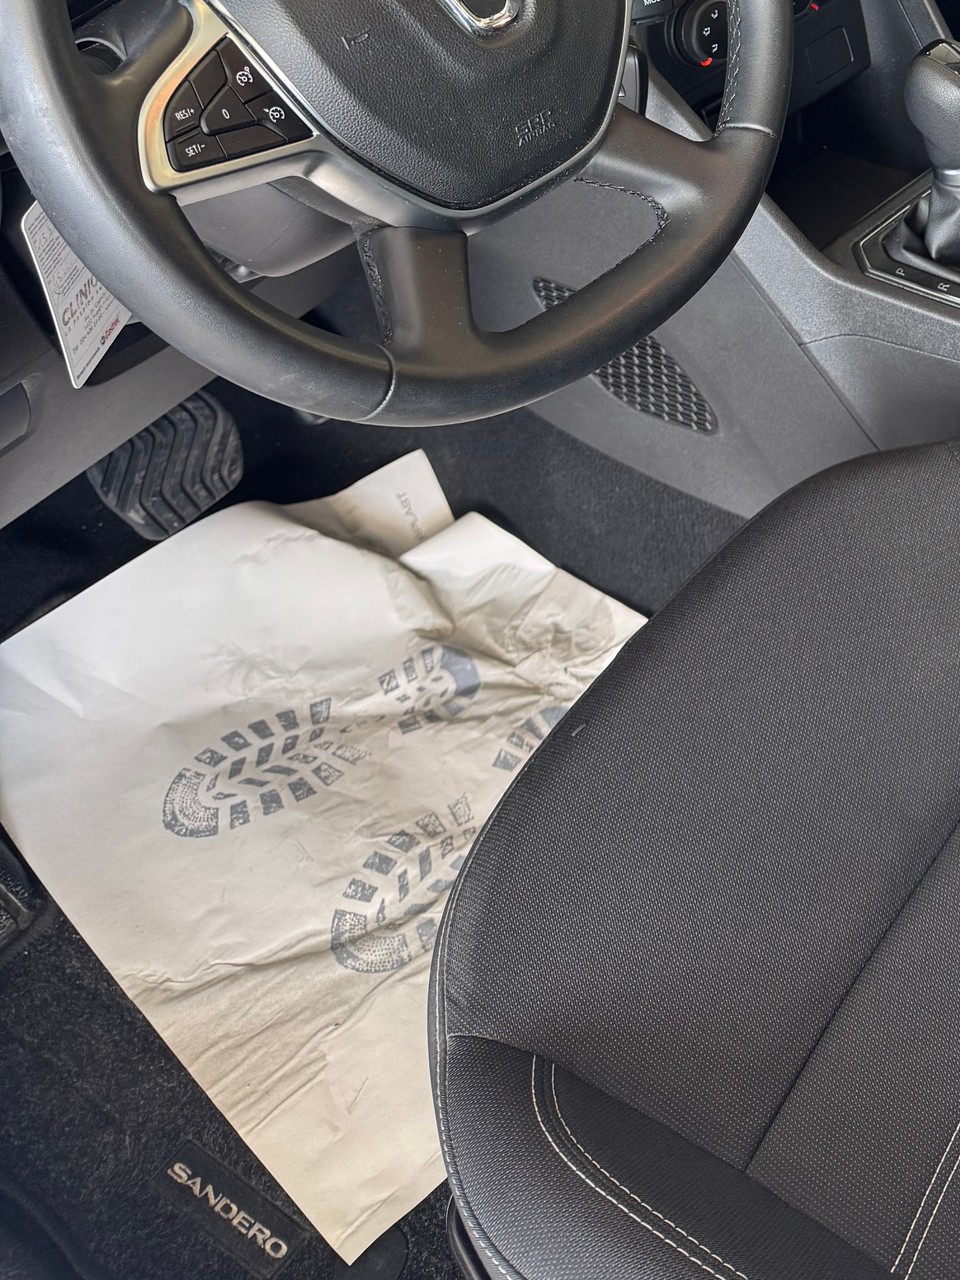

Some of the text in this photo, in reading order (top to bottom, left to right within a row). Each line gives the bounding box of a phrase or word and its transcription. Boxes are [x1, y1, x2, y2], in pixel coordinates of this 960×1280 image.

[174, 108, 195, 121] RES/+
[185, 143, 206, 157] SET/-
[895, 267, 905, 276] P
[937, 282, 950, 292] R
[167, 1162, 288, 1259] SANDERO
